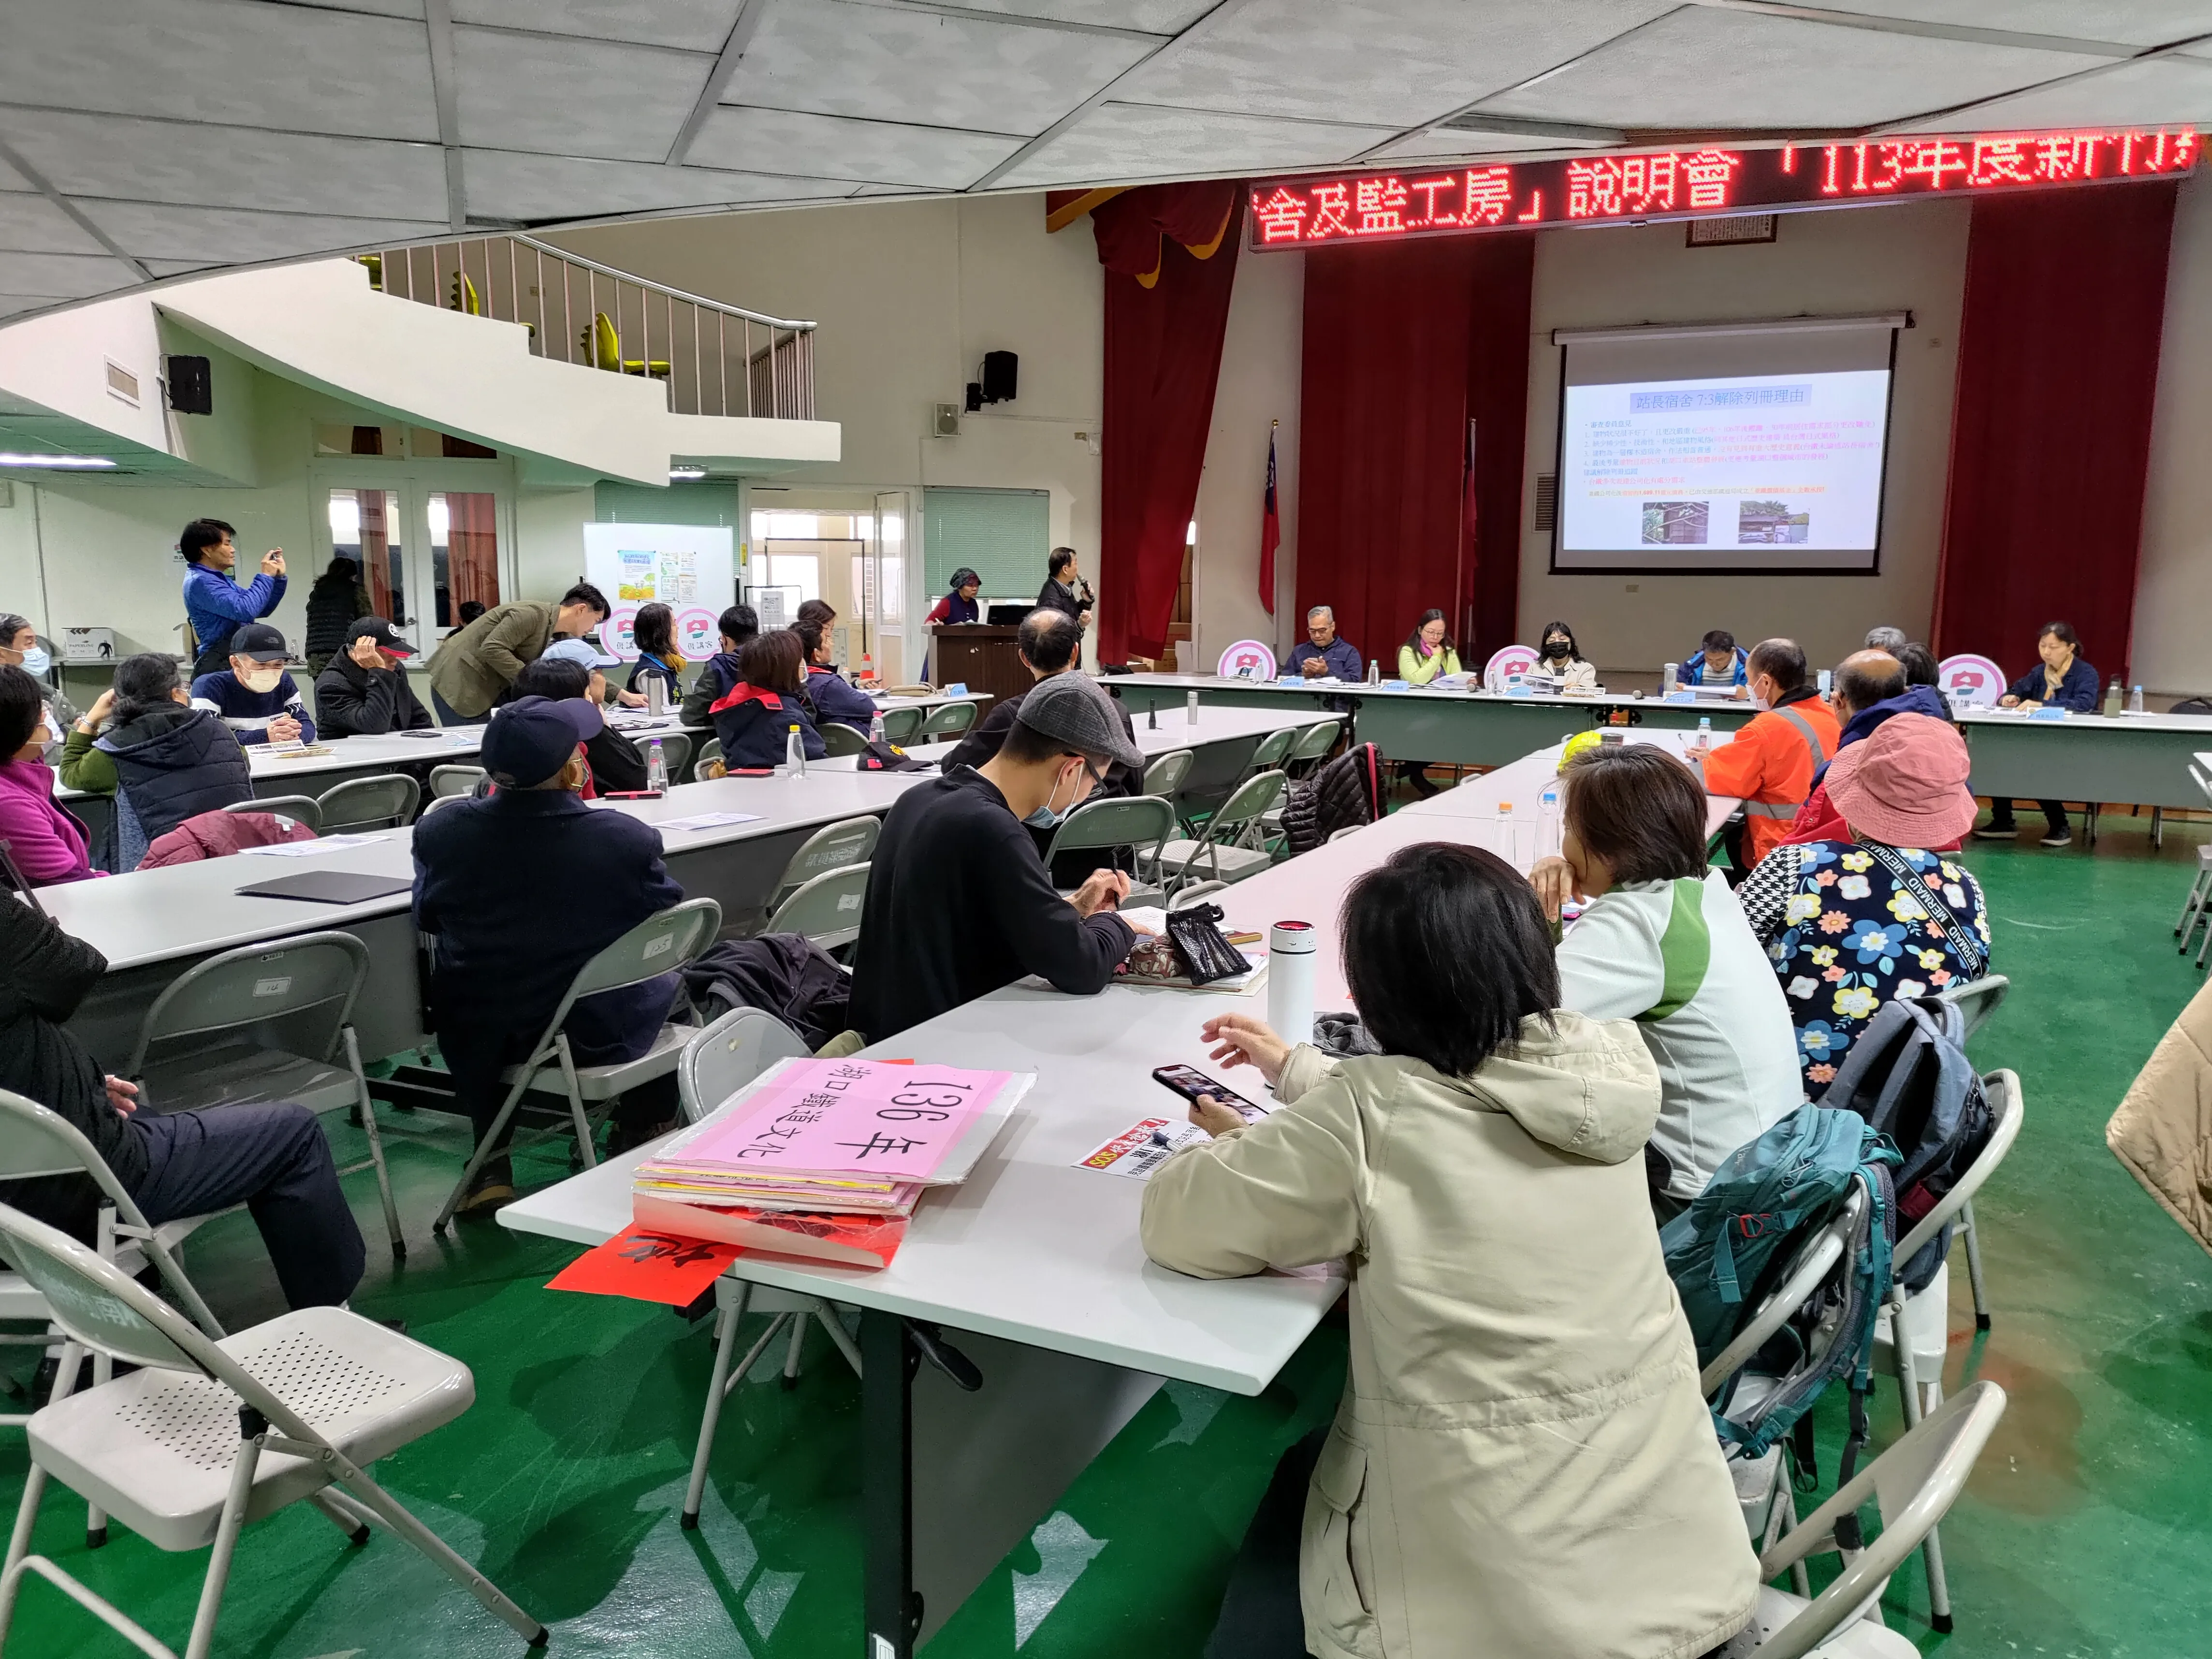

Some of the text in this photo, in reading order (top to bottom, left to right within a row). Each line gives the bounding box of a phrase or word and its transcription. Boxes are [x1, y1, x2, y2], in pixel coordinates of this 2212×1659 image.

[1568, 147, 1739, 217] 說明會
[1637, 394, 1693, 409] 站長宿舍
[1908, 877, 1948, 923] MERMAID
[1948, 926, 1979, 971] MERMAID
[737, 1064, 873, 1158] 湖口鐵道文化
